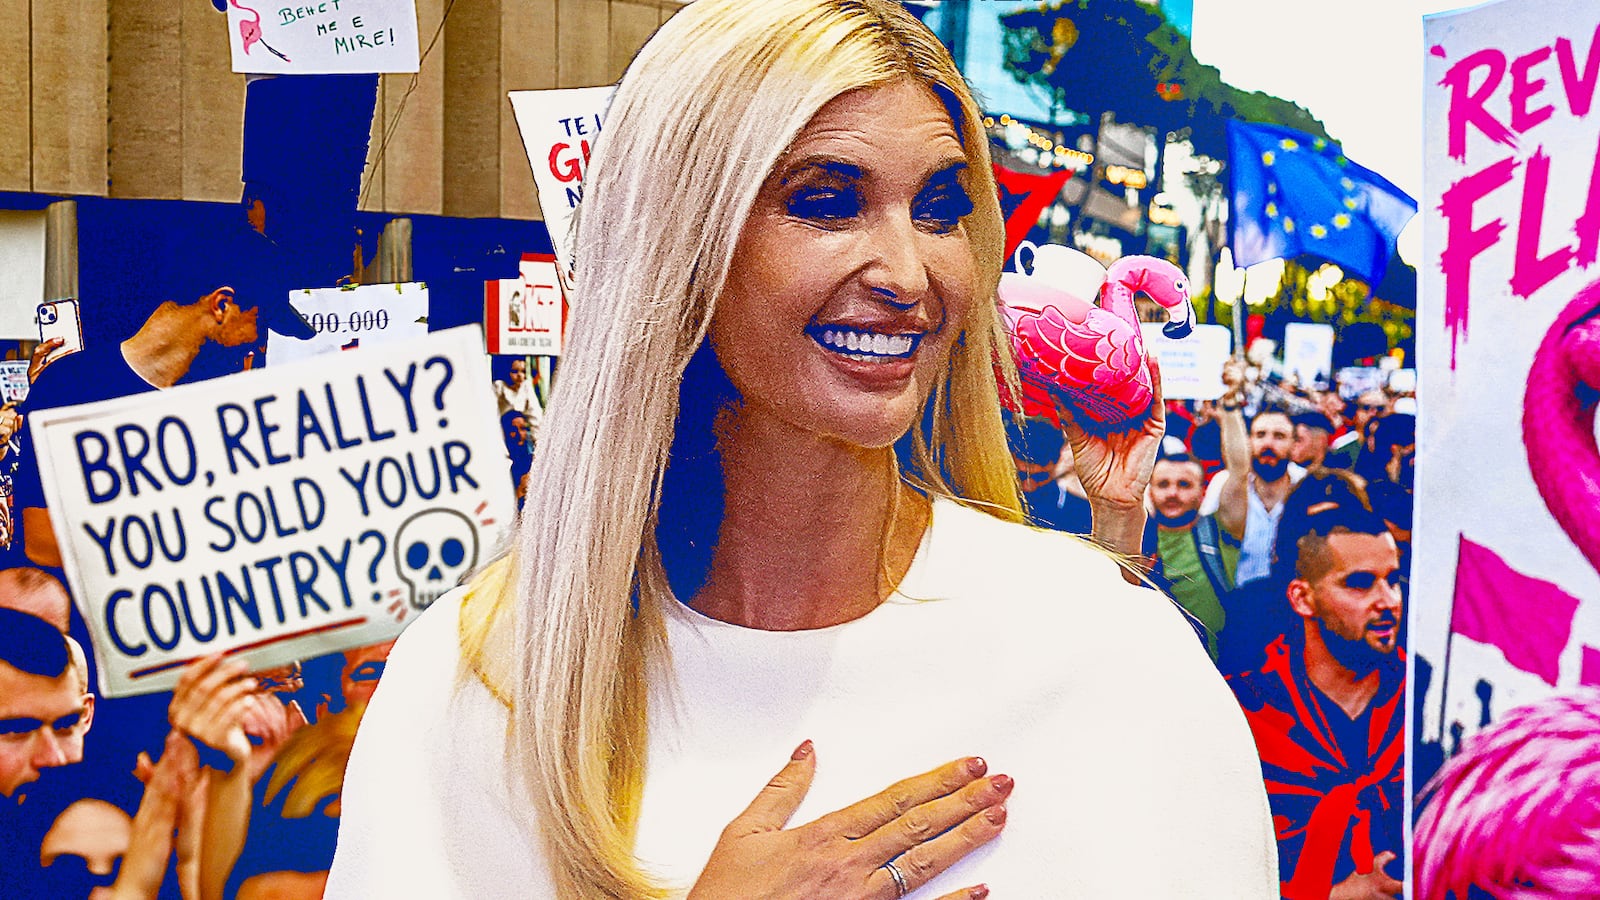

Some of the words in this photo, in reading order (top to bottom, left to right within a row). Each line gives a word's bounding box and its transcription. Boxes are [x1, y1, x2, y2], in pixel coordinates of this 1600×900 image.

[334, 28, 394, 55] MIRE!
[352, 16, 364, 28] E
[558, 116, 588, 137] TE
[74, 416, 214, 504] BRO,
[216, 356, 454, 475] REALLY?
[84, 508, 187, 576] YOU
[204, 478, 325, 554] SOLD
[339, 440, 478, 517] YOUR
[105, 530, 387, 658] COUNTRY?
